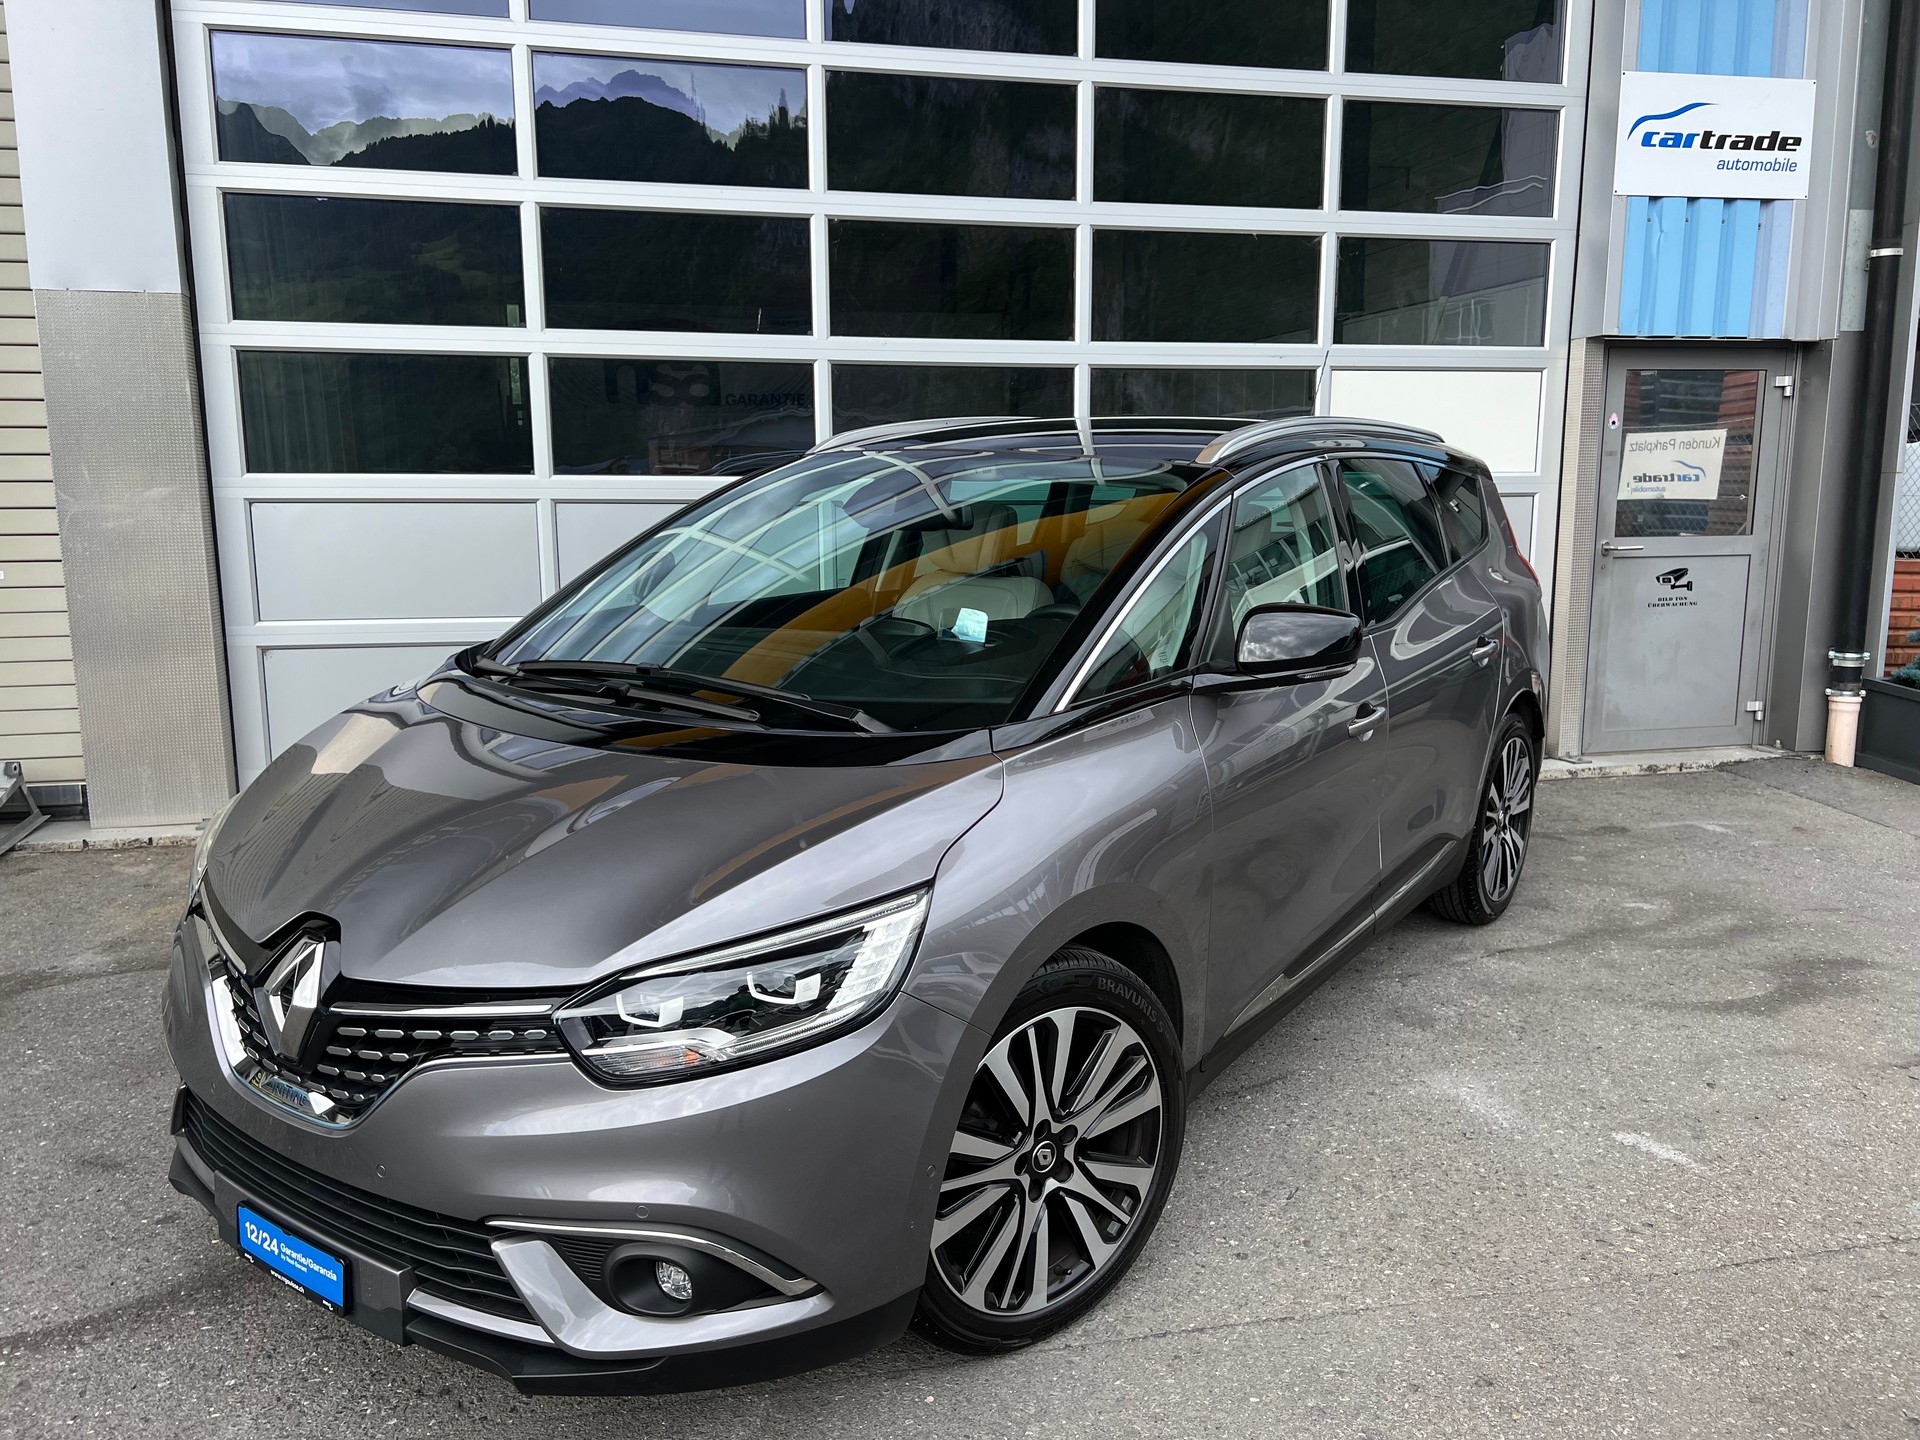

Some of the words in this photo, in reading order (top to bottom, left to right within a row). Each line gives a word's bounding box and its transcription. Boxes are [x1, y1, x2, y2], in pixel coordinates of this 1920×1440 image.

[1640, 130, 1802, 152] cartrade
[1716, 158, 1797, 173] automobile
[725, 392, 806, 407] GARANTIE
[1097, 977, 1157, 1023] BRAVURIS
[1155, 1022, 1164, 1032] 5
[245, 1221, 279, 1256] 12/24
[280, 1242, 337, 1281] Garantie/Garanzia
